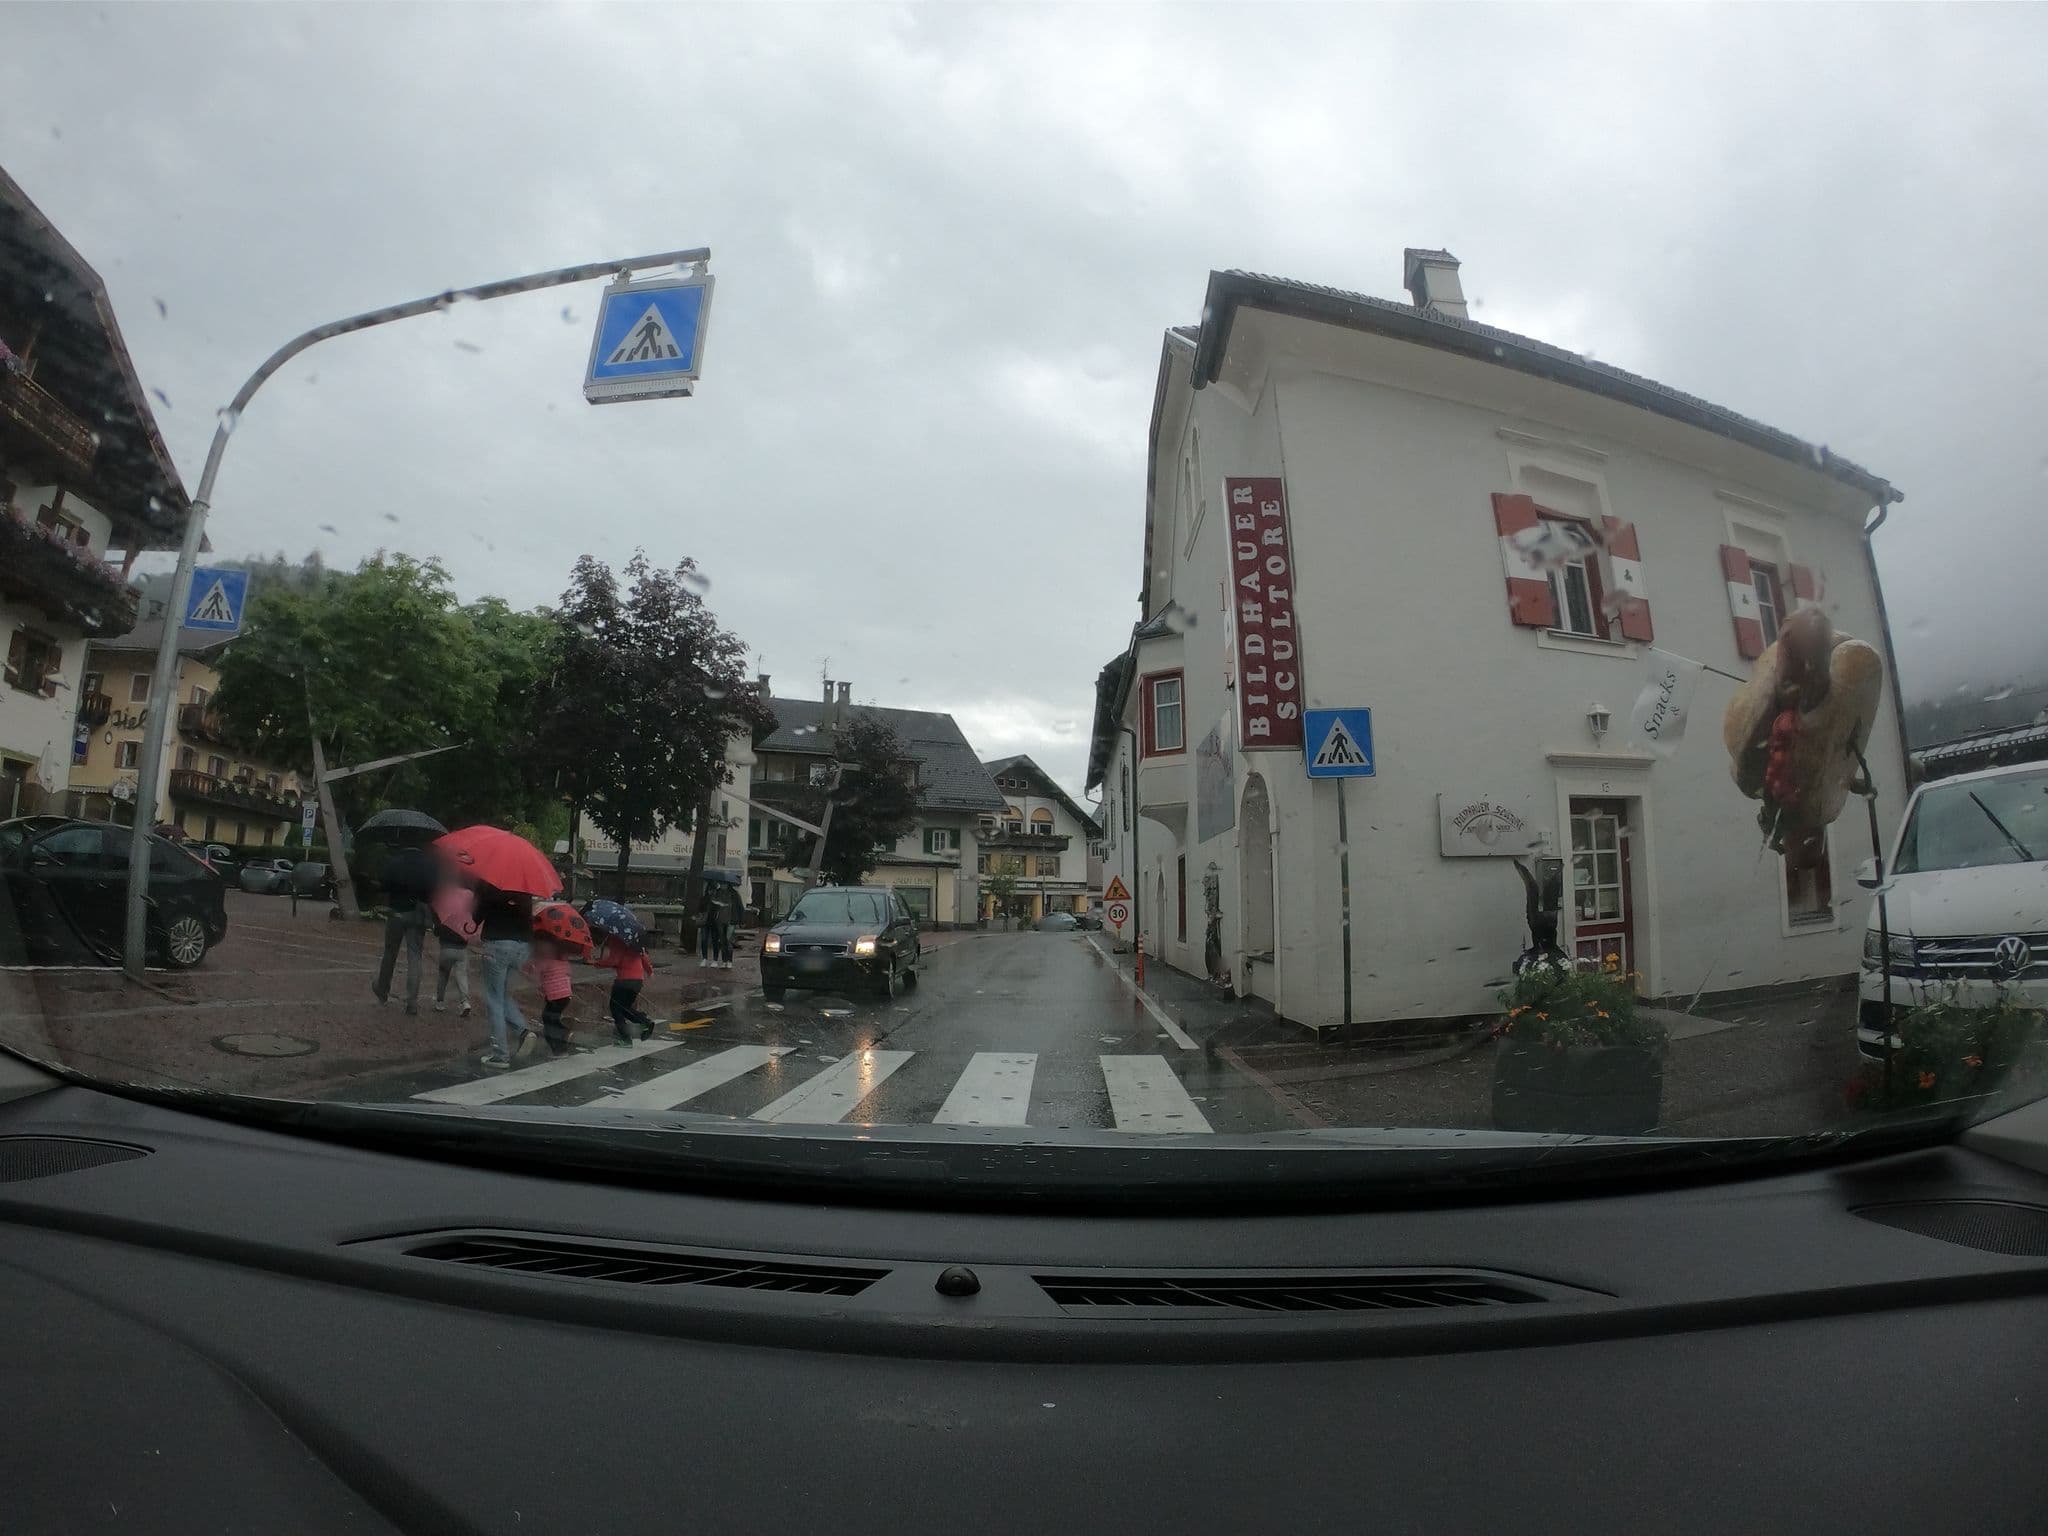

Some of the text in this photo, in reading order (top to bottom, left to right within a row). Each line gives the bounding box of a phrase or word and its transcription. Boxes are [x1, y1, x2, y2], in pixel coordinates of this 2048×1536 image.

[1233, 486, 1271, 737] BILDHAUER
[1261, 500, 1297, 720] SCULTORE
[1643, 670, 1676, 740] Snacks
[1112, 909, 1124, 919] 30
